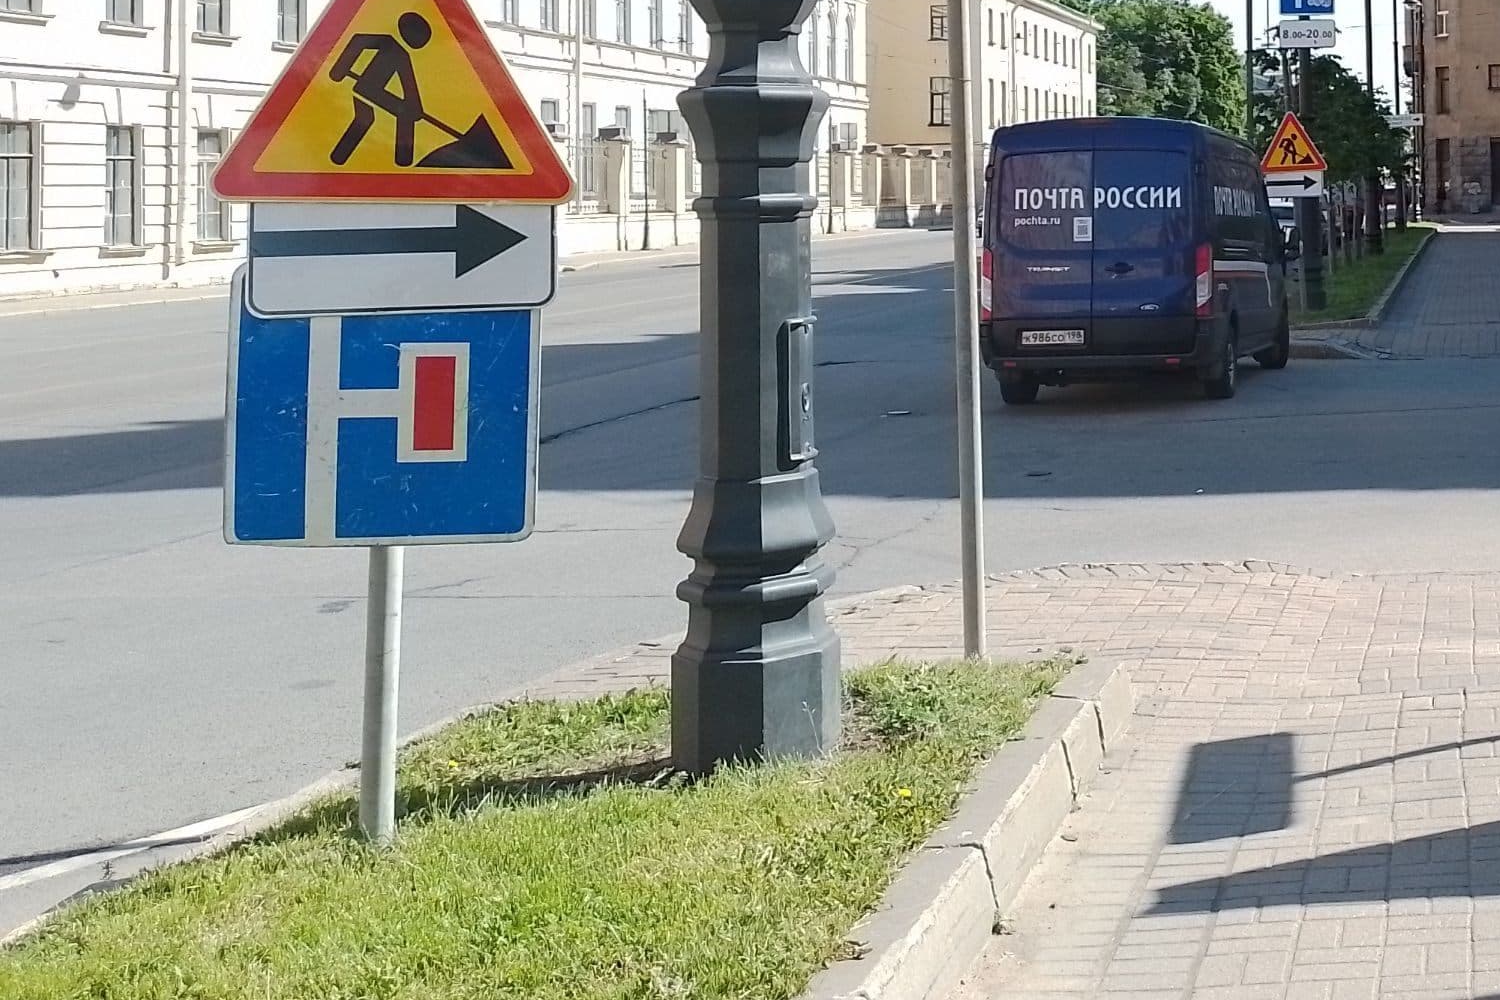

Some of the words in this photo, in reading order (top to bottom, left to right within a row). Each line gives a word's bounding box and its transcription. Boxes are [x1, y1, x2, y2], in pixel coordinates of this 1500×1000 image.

[1014, 187, 1085, 210] ПОЧТА
[1094, 186, 1181, 209] РОССИИ
[1014, 216, 1061, 227] pochta.ru
